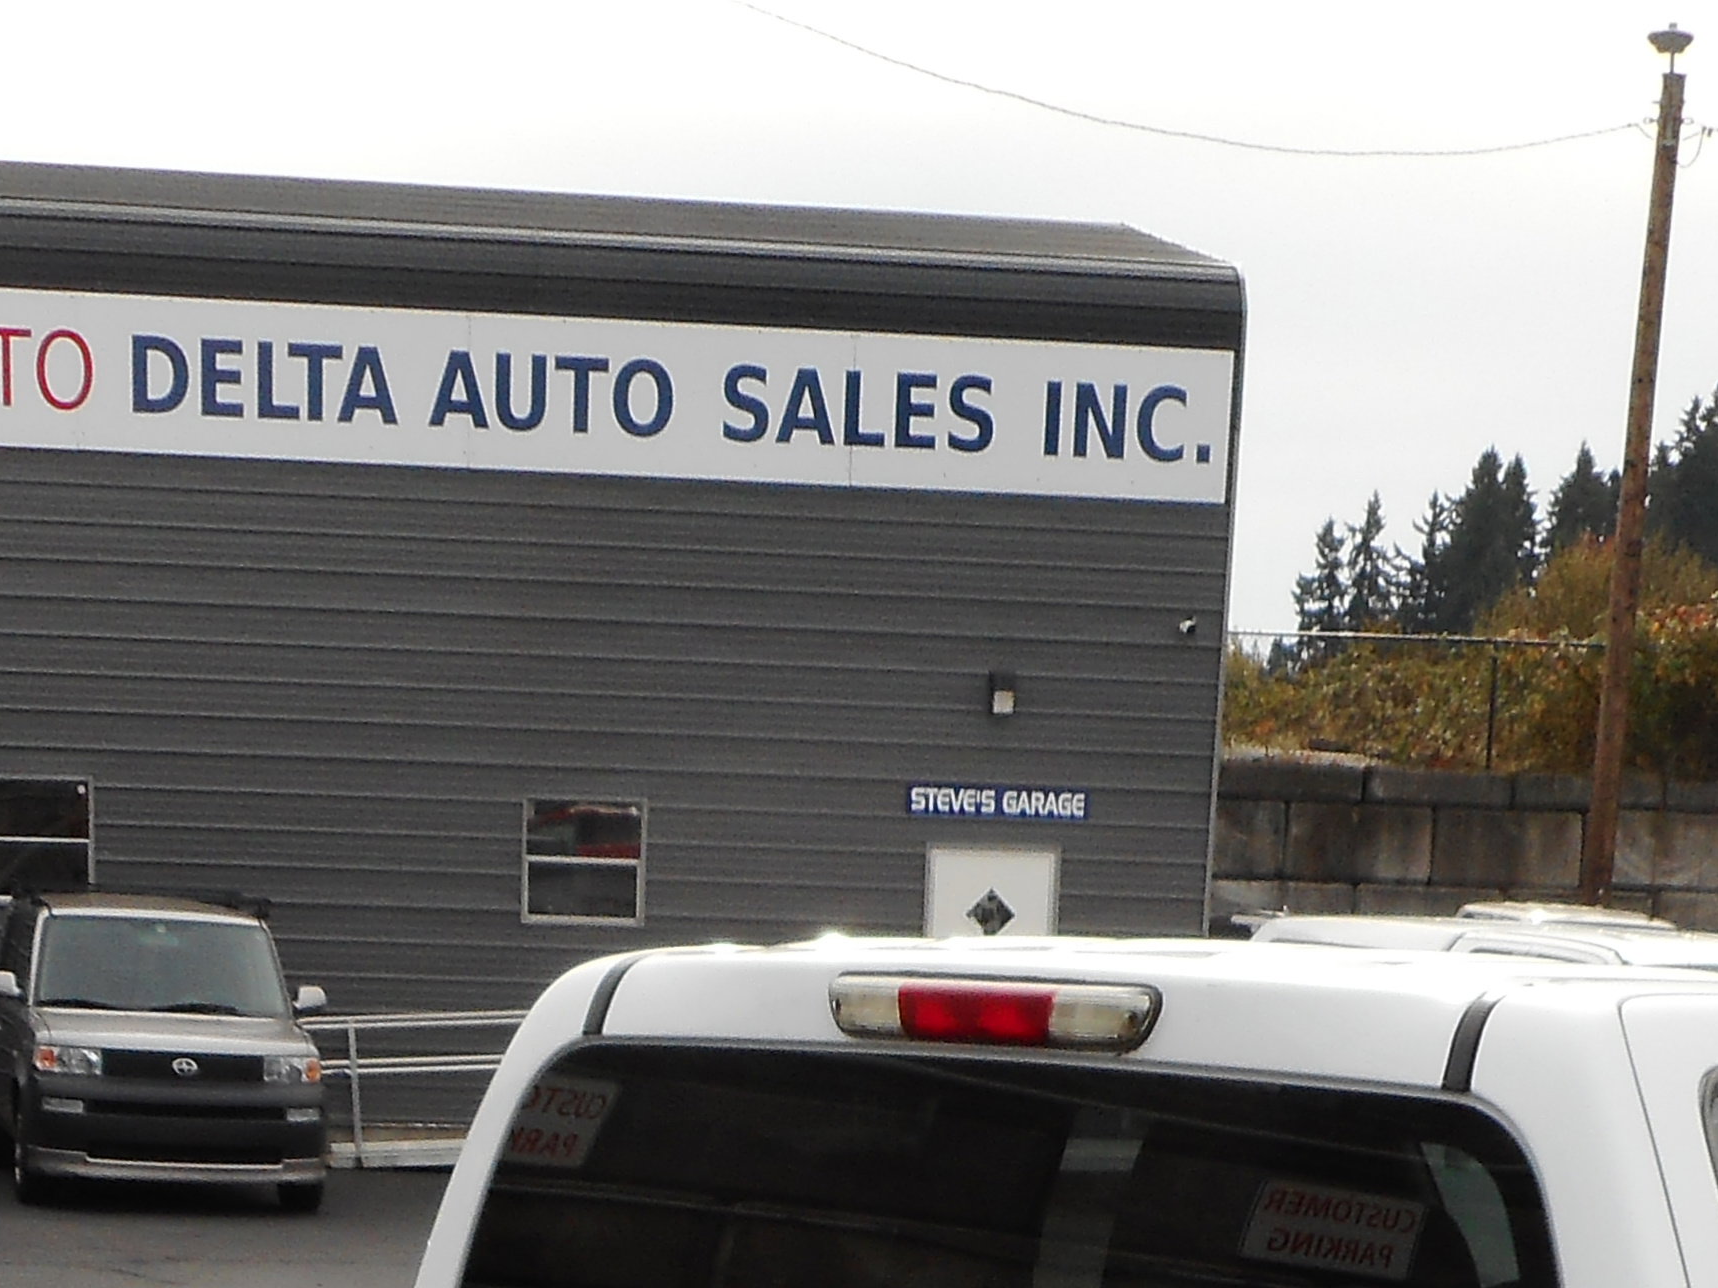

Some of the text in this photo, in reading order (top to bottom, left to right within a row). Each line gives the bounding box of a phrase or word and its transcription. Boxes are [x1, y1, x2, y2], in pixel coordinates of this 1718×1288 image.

[131, 334, 399, 425] DELTA
[428, 349, 674, 438] AUTO
[722, 363, 995, 453] SALES
[1043, 380, 1211, 464] INC.
[910, 786, 1085, 816] STEVE'S GARAGE
